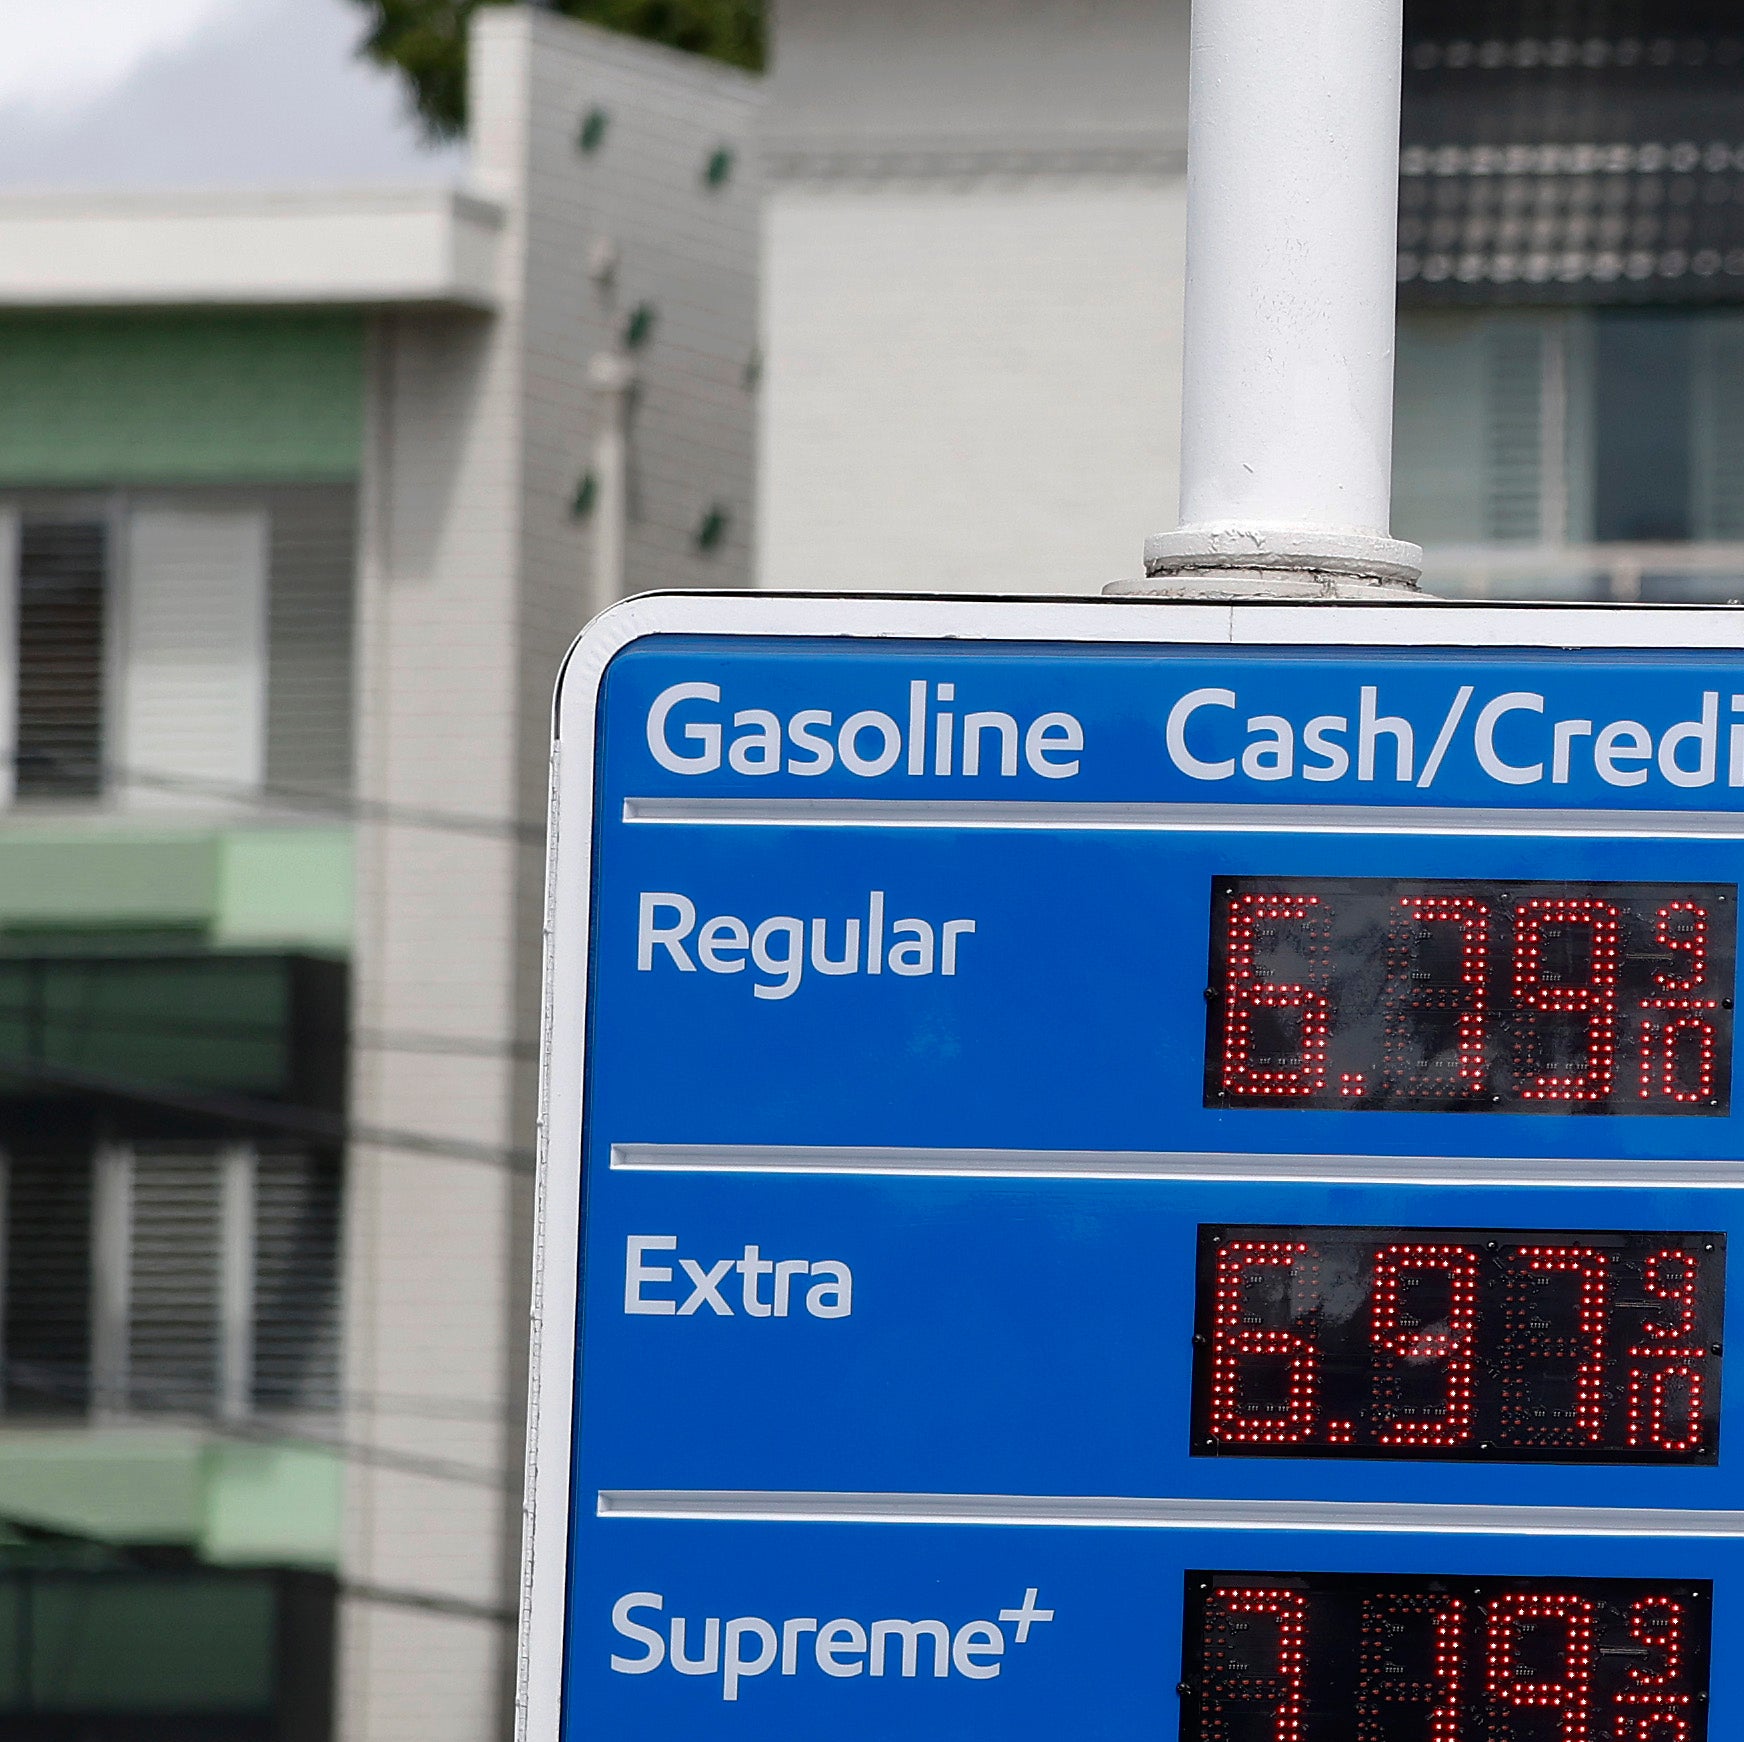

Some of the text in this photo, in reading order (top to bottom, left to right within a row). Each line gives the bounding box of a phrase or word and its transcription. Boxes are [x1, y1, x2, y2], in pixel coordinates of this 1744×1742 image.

[645, 680, 1086, 781] Gasoline
[637, 891, 979, 1002] Regular
[1222, 894, 1621, 1101] 6.79
[624, 1235, 854, 1321] Extra
[1211, 1242, 1608, 1447] 6.97
[610, 1587, 1056, 1703] Supreme+
